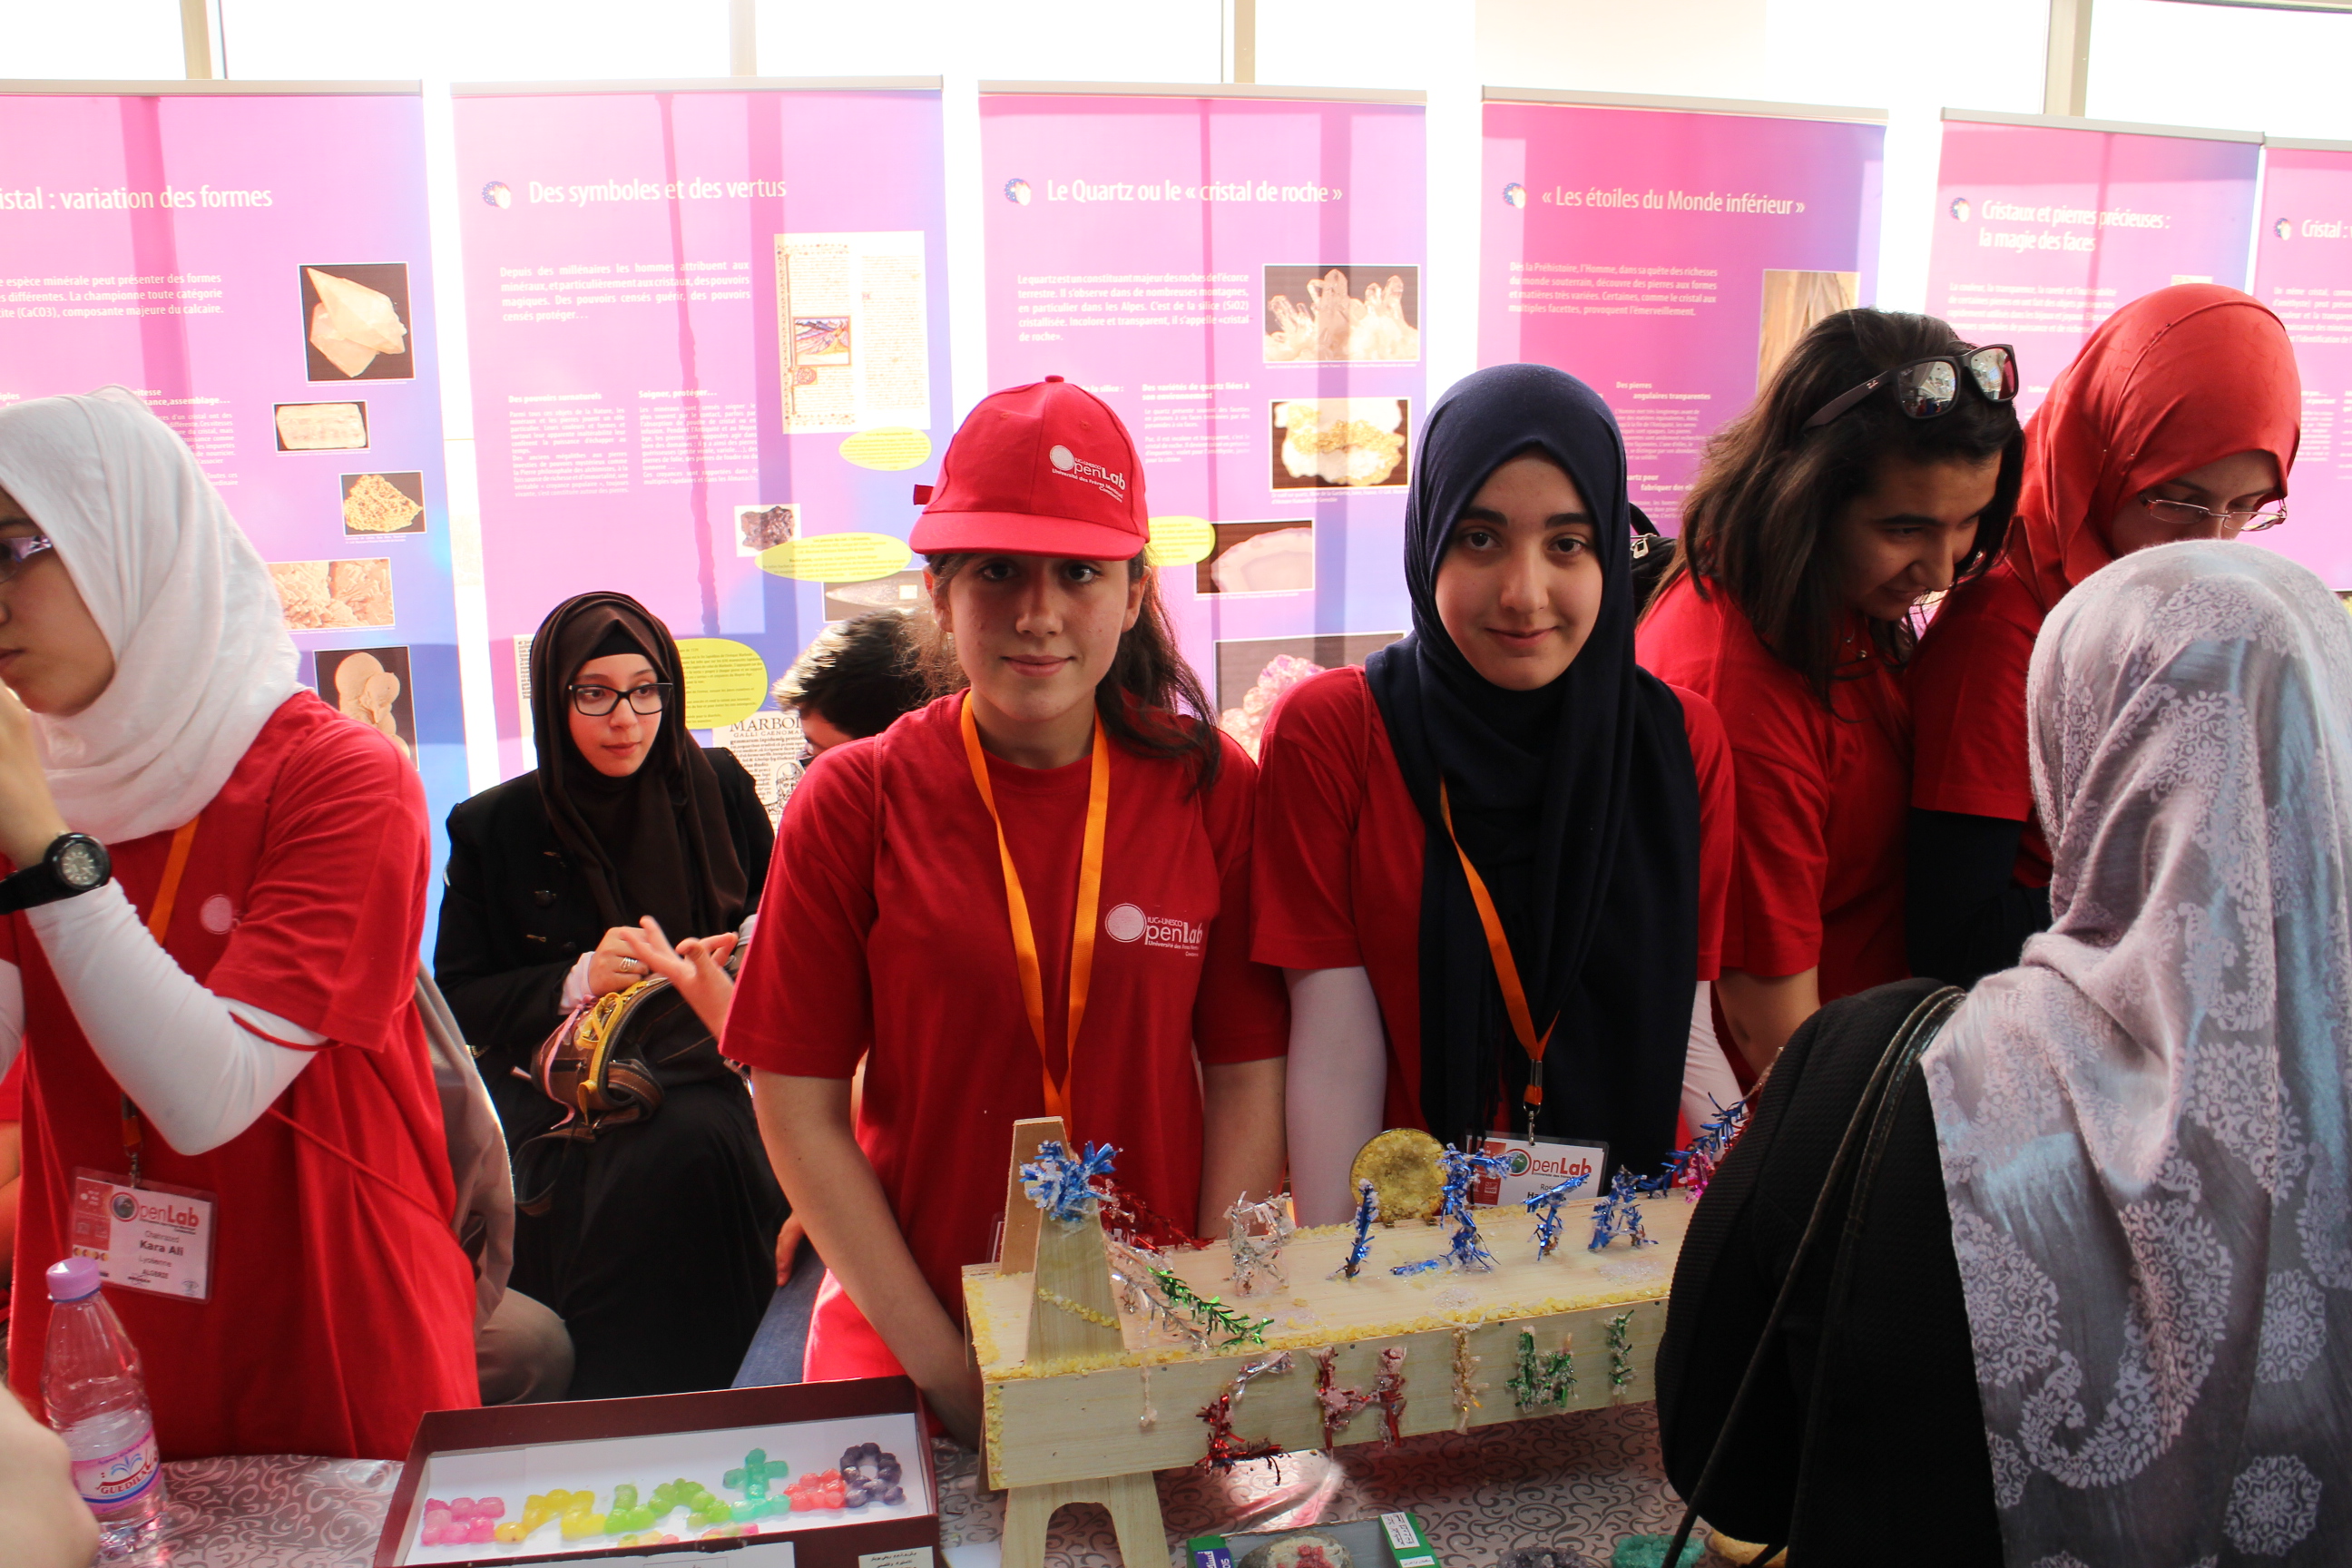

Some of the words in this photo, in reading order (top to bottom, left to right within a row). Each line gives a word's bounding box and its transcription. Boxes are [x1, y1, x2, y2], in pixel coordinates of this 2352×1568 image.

[0, 186, 43, 210] istal
[49, 192, 54, 210] :
[60, 186, 153, 210] variation
[160, 184, 195, 208] des
[201, 184, 272, 207] formes
[529, 180, 564, 203] Des
[568, 177, 661, 208] symboles
[664, 180, 684, 200] et
[688, 176, 722, 199] des
[726, 180, 787, 198] vertus
[1047, 179, 1068, 201] Le
[1072, 179, 1133, 202] Quartz
[1137, 184, 1160, 201] ou
[1165, 179, 1181, 201] le
[1184, 187, 1196, 200] «
[1199, 180, 1251, 201] cristal
[1255, 180, 1278, 201] de
[1281, 179, 1328, 202] roche
[1332, 189, 1342, 200] »
[1542, 191, 1552, 202] «
[1555, 185, 1582, 206] Les
[1585, 186, 1639, 208] étoiles
[1642, 188, 1663, 210] du
[1667, 190, 1722, 211] Monde
[1726, 191, 1794, 214] inférieur
[1796, 202, 1804, 212] »
[1981, 199, 2035, 222] Cristaux
[2036, 205, 2051, 222] et
[2052, 201, 2097, 229] pierres
[2098, 206, 2163, 233] précieuses
[2165, 215, 2171, 229] :
[2301, 219, 2343, 239] Cristal
[2342, 225, 2349, 239] :
[1978, 226, 1993, 247] la
[1994, 229, 2036, 252] magie
[2037, 230, 2061, 250] des
[2063, 227, 2095, 254] faces
[499, 266, 532, 279] Depuis
[537, 265, 554, 276] des
[559, 263, 611, 275] millénaires
[615, 262, 630, 273] les
[634, 262, 675, 273] hommes
[680, 260, 727, 271] attribuent
[731, 260, 750, 270] aux
[1510, 261, 1524, 271] Dès
[1525, 262, 1533, 271] la
[1534, 262, 1579, 272] Préhistoire,
[1618, 264, 1637, 274] dans
[1646, 265, 1670, 277] quête
[1669, 266, 1684, 275] des
[1683, 267, 1718, 277] richesses
[5, 275, 41, 289] espèce
[43, 275, 89, 286] minérale
[92, 276, 115, 287] peut
[118, 273, 164, 287] présenter
[167, 273, 184, 284] des
[187, 272, 221, 283] formes
[1510, 276, 1522, 285] du
[1522, 276, 1550, 286] monde
[1552, 278, 1594, 287] souterrain,
[1596, 278, 1631, 288] découvre
[1633, 279, 1646, 288] des
[1647, 279, 1673, 290] pierres
[1691, 279, 1717, 289] formes
[7, 290, 66, 302] différentes.
[69, 290, 82, 301] La
[83, 289, 145, 303] championne
[147, 290, 174, 299] toute
[176, 288, 222, 301] catégorie
[502, 297, 550, 309] magiques.
[554, 294, 572, 305] Des
[576, 293, 616, 306] pouvoirs
[620, 291, 652, 302] censés
[655, 291, 686, 304] guérir,
[690, 290, 706, 300] des
[710, 289, 751, 301] pouvoirs
[1017, 289, 1057, 299] terrestre.
[1060, 288, 1066, 298] Il
[1110, 287, 1131, 297] dans
[1132, 287, 1143, 297] de
[1145, 287, 1197, 296] nombreuses
[1199, 288, 1250, 300] montagnes,
[62, 307, 123, 318] composante
[125, 305, 165, 318] majeure
[168, 304, 181, 314] du
[182, 303, 223, 314] calcaire.
[1017, 305, 1029, 313] en
[1032, 302, 1078, 314] particulier
[1081, 301, 1102, 311] dans
[1105, 301, 1118, 311] les
[1121, 301, 1147, 313] Alpes.
[1172, 300, 1184, 310] de
[1187, 300, 1194, 310] la
[1198, 301, 1219, 312] silice
[503, 311, 534, 322] censés
[1018, 317, 1067, 327] cristallisée.
[1069, 316, 1105, 326] Incolore
[1106, 317, 1116, 326] et
[1117, 316, 1170, 327] transparent,
[1171, 315, 1178, 324] il
[638, 388, 671, 400] Soigner,
[1142, 383, 1156, 391] Des
[1156, 383, 1187, 394] variétés
[1188, 382, 1198, 390] de
[1199, 383, 1224, 392] quartz
[1225, 381, 1243, 389] liées
[1244, 381, 1250, 389] à
[508, 394, 523, 403] Des
[523, 394, 557, 404] pouvoirs
[557, 392, 602, 401] surnaturels
[1156, 392, 1212, 400] environnement
[730, 717, 802, 732] MARBO
[140, 1240, 165, 1252] Kara
